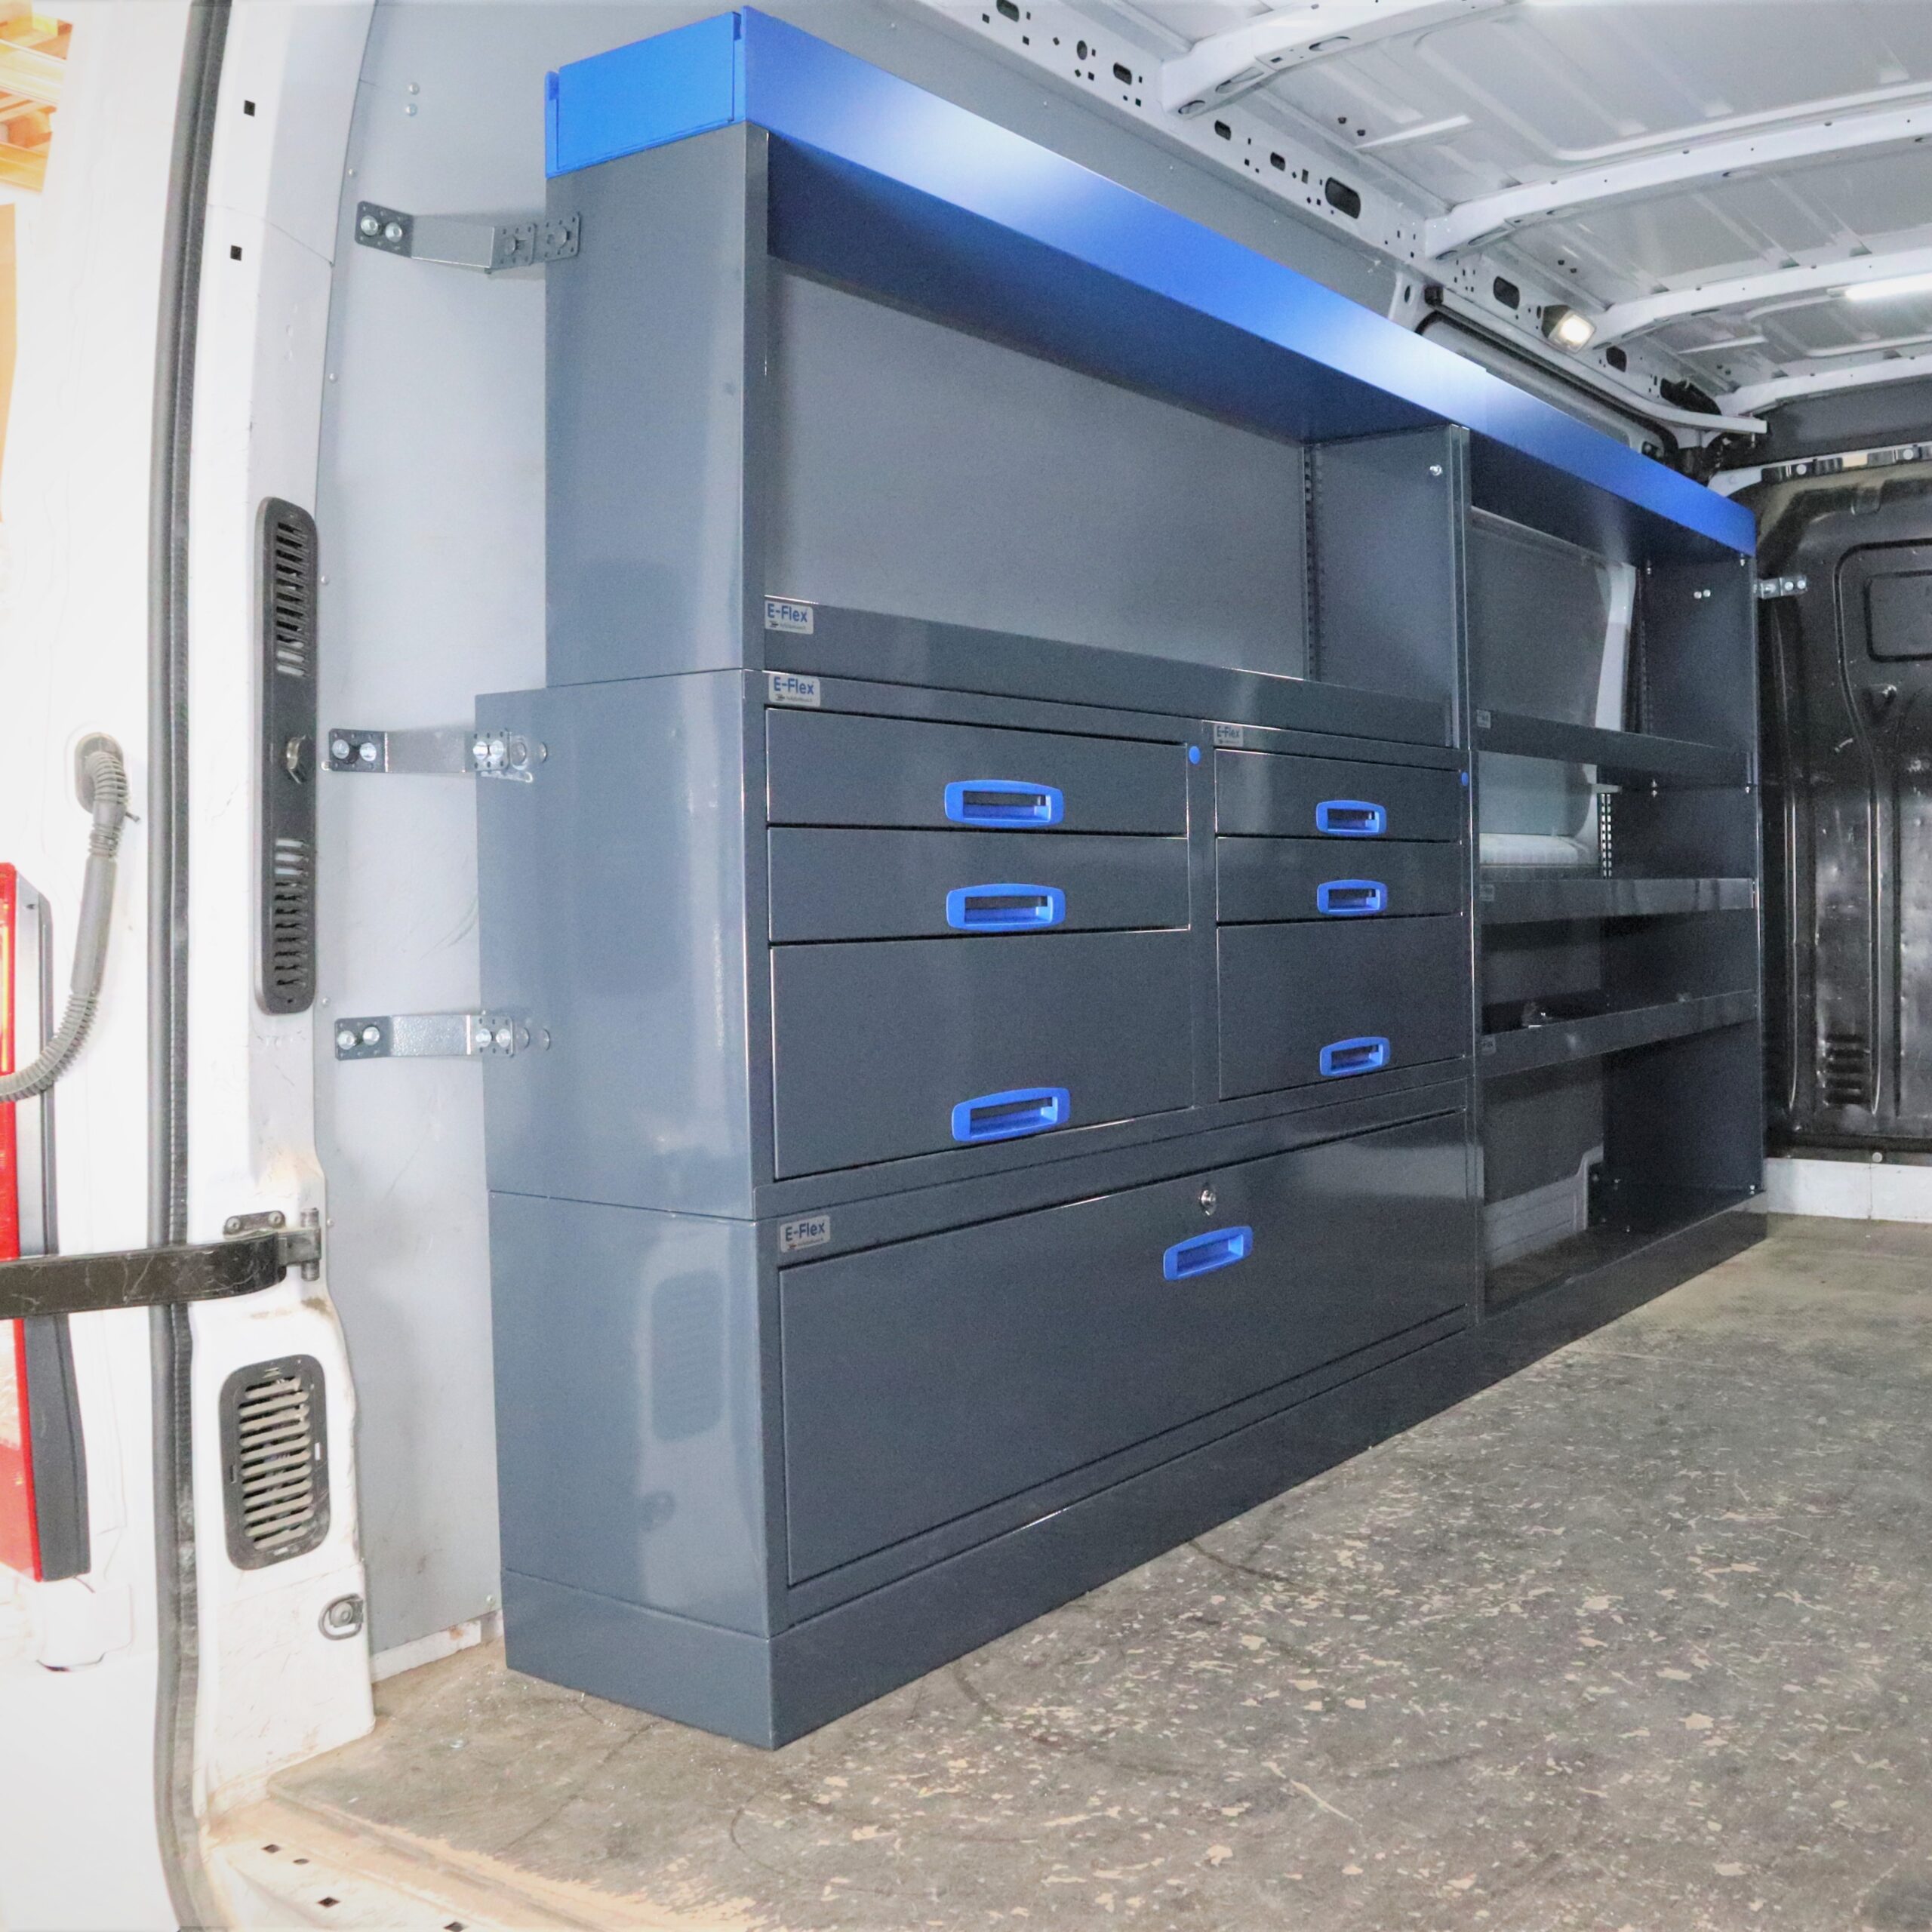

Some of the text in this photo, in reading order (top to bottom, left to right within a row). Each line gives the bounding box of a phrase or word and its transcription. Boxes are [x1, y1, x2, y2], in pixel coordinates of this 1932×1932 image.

[768, 603, 808, 623] E-Flex
[774, 676, 814, 695] E-Flex
[786, 1223, 825, 1241] E-Flex
